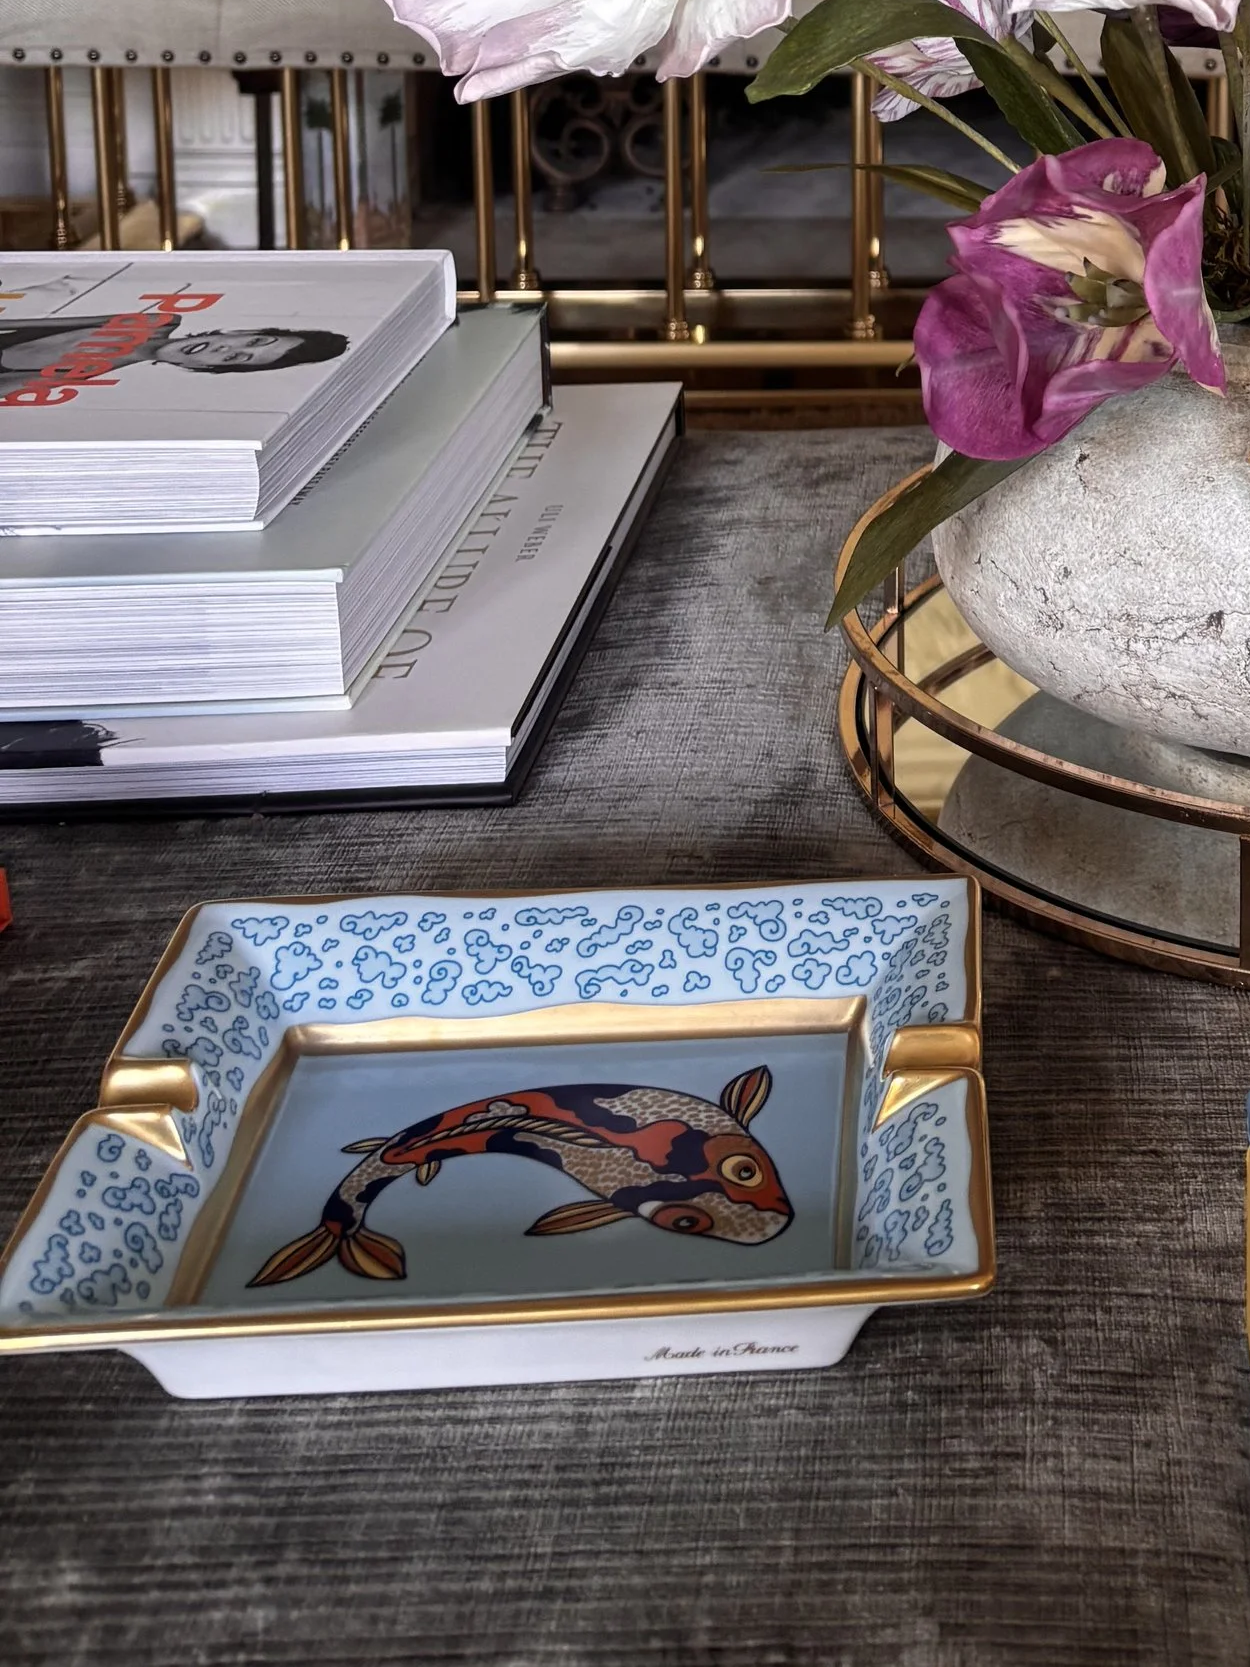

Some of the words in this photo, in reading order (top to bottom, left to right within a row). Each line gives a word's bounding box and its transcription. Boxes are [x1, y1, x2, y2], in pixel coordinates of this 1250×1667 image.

[0, 292, 226, 407] Pamela
[515, 524, 552, 562] WEBER
[644, 1346, 704, 1361] Made
[711, 1346, 731, 1357] in
[733, 1341, 799, 1356] France
